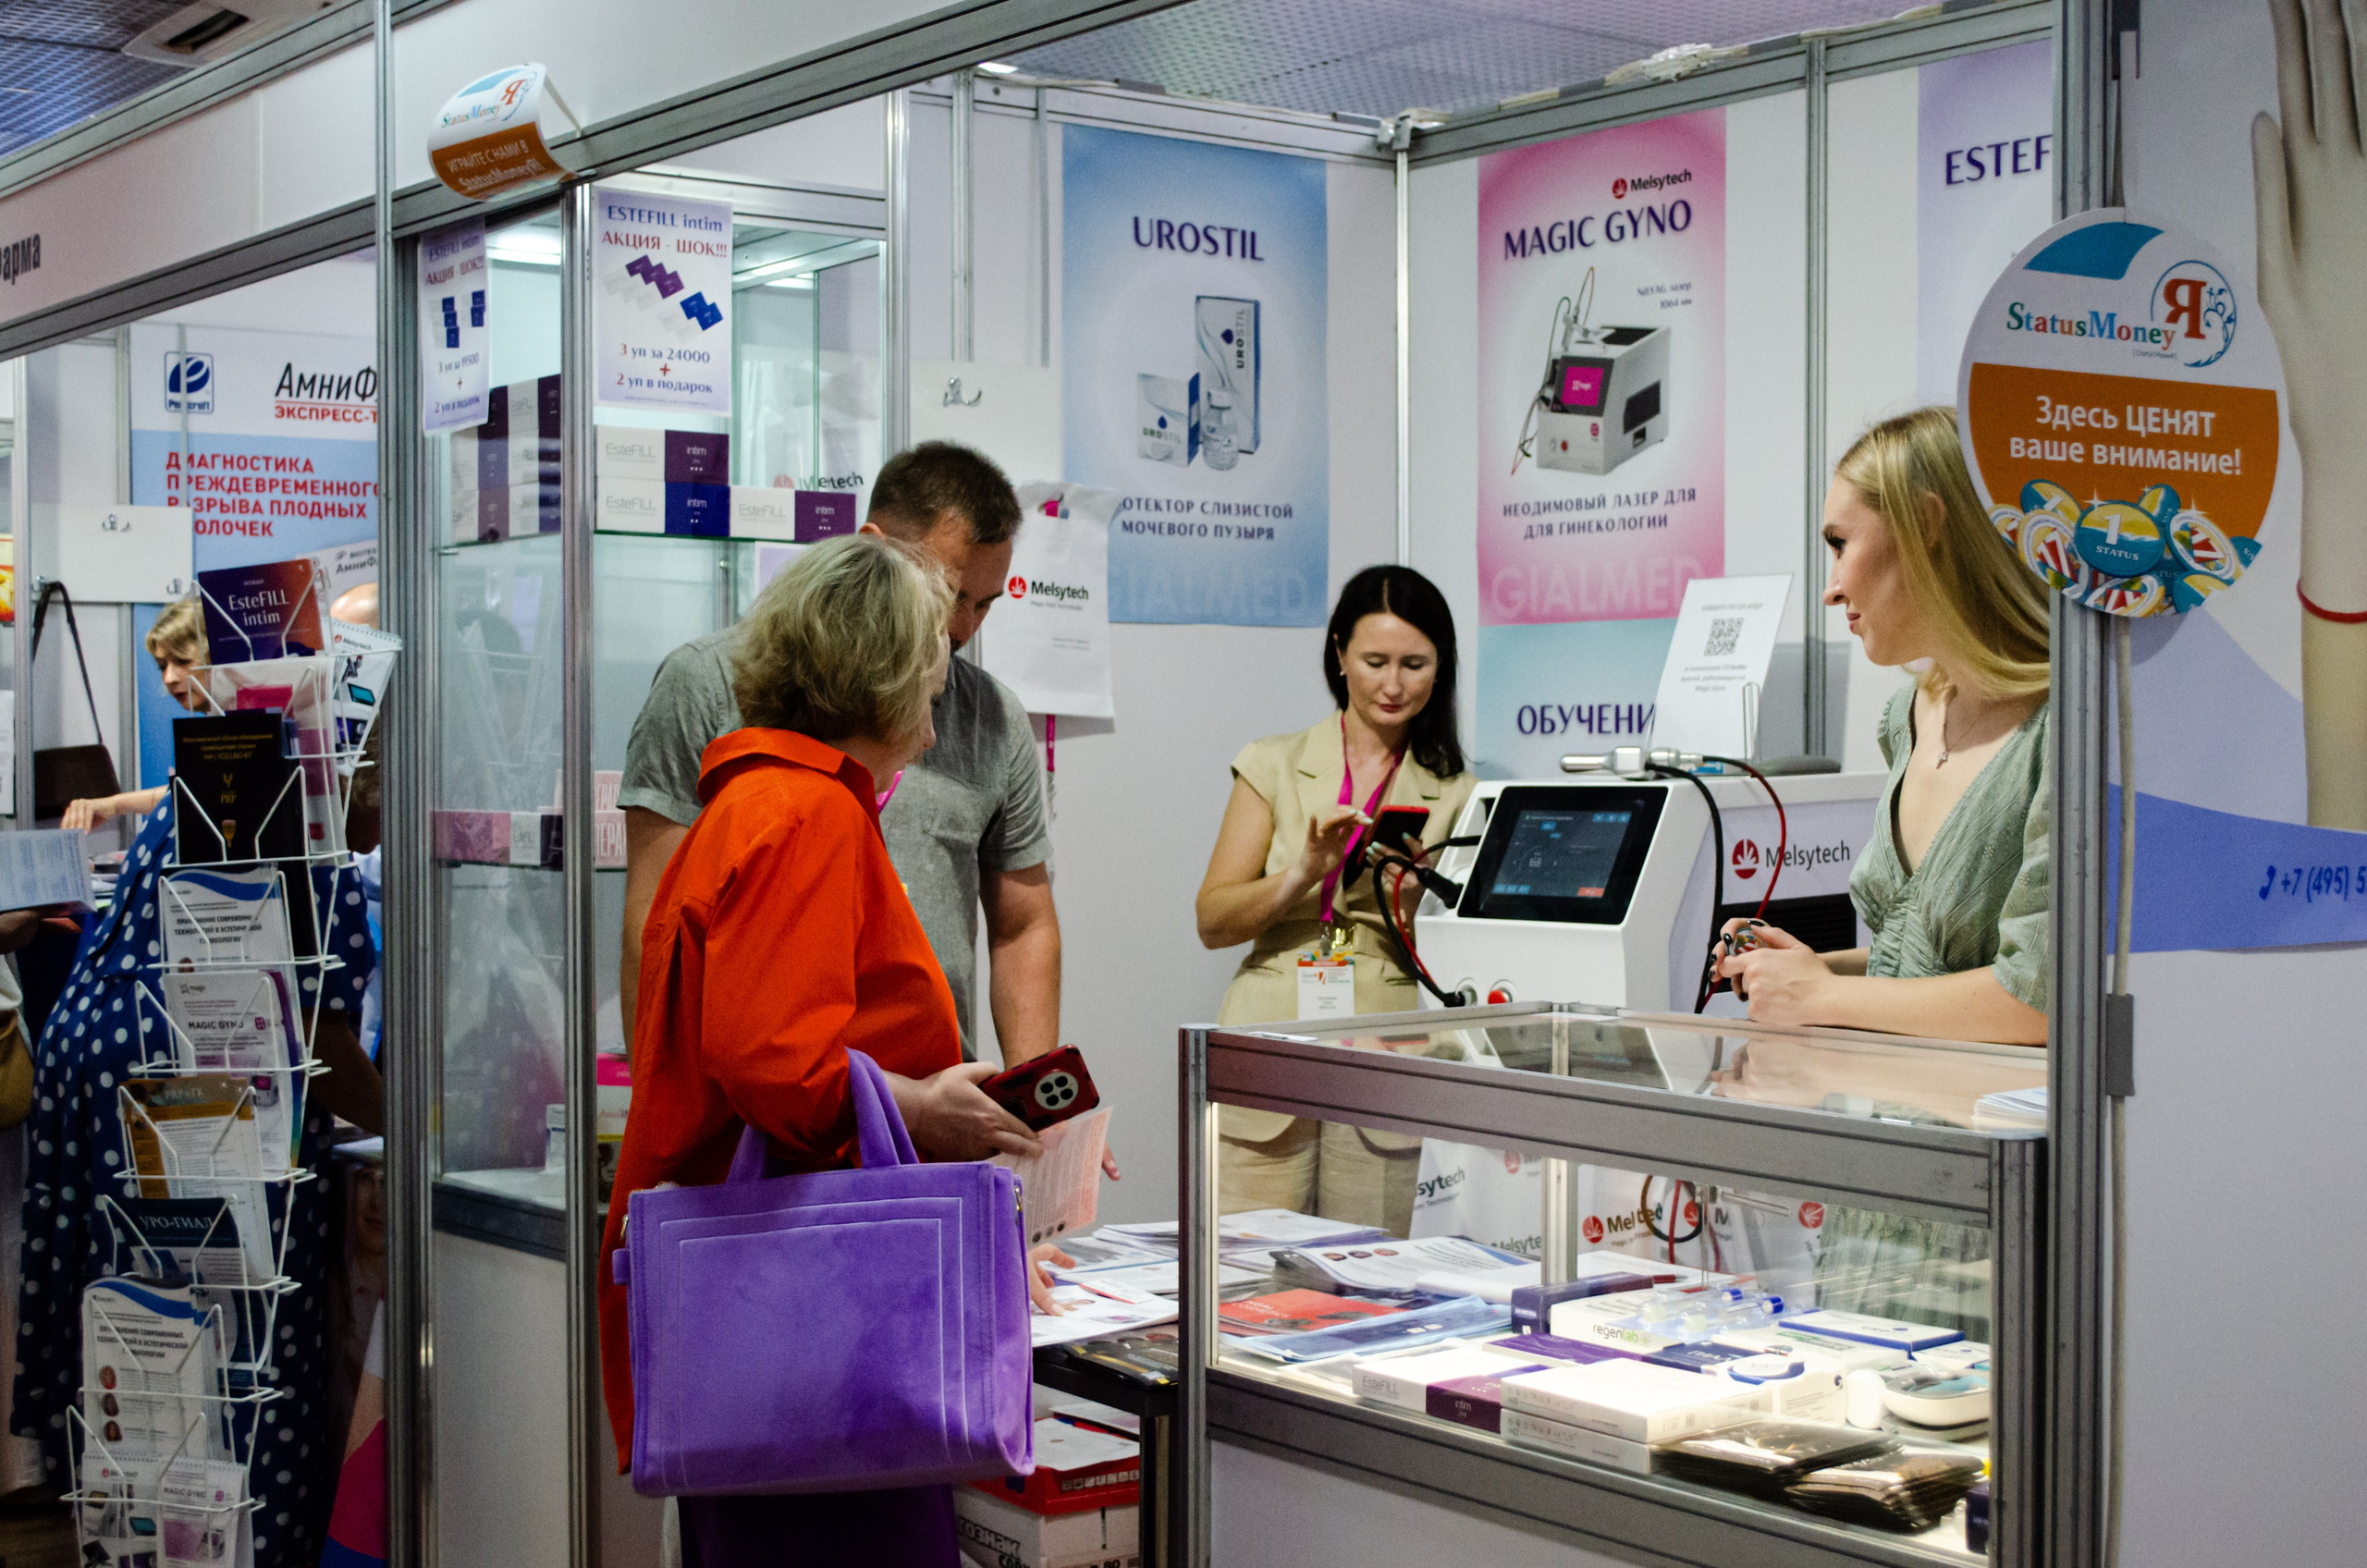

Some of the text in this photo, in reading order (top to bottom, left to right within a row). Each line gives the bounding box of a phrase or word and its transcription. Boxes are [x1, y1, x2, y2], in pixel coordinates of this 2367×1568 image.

[1630, 168, 1692, 192] Melsytech
[607, 204, 723, 232] ESTEFILL intim
[1132, 215, 1265, 262] UROSTIL
[1503, 199, 1693, 261] MAGIC GYNO
[601, 230, 662, 251] АКЦИЯ
[676, 239, 728, 258] ШОК!!!
[2006, 300, 2176, 351] StatusMoney
[1235, 308, 1245, 370] UROSTIL
[619, 343, 711, 363] 3 уп за 24000
[275, 361, 378, 402] АмниФ
[617, 373, 713, 395] 2 уп в подарок
[2035, 395, 2216, 438] Здесь ЦЕНЯТ
[606, 443, 706, 458] EsteFILL intim
[2009, 437, 2242, 477] ваше внимание!
[166, 452, 314, 473] ДИАГНОСТИКА
[167, 496, 367, 520] РЗРЫВА ПЛОДНЫХ
[606, 496, 706, 510] EsteFILL intim
[739, 503, 787, 518] EsteFILL
[1199, 499, 1294, 520] СЛИЗИСТОЙ
[1502, 487, 1698, 518] НЕОДИМОВЫЙ ЛАЗЕР ДЛЯ
[194, 520, 273, 537] ОЛОЧЕК
[1122, 520, 1275, 541] МОЧЕВОГО ПУЗЫРЯ
[1523, 514, 1669, 541] ДЛЯ ГИНЕКОЛОГИИ
[2095, 545, 2140, 561] STATUS
[228, 588, 290, 611] EsteFILL
[1031, 580, 1089, 601] Melsytech
[243, 610, 281, 627] intim
[1765, 839, 1850, 871] Melsytech
[2281, 867, 2302, 896] +7
[2306, 864, 2349, 903] (495)
[188, 1021, 216, 1029] MAGIC
[141, 1216, 213, 1230] УРО-ГИАЛ
[1592, 1321, 1641, 1345] regenlab
[1362, 1375, 1399, 1396] EsteFILL
[1454, 1398, 1472, 1411] intim
